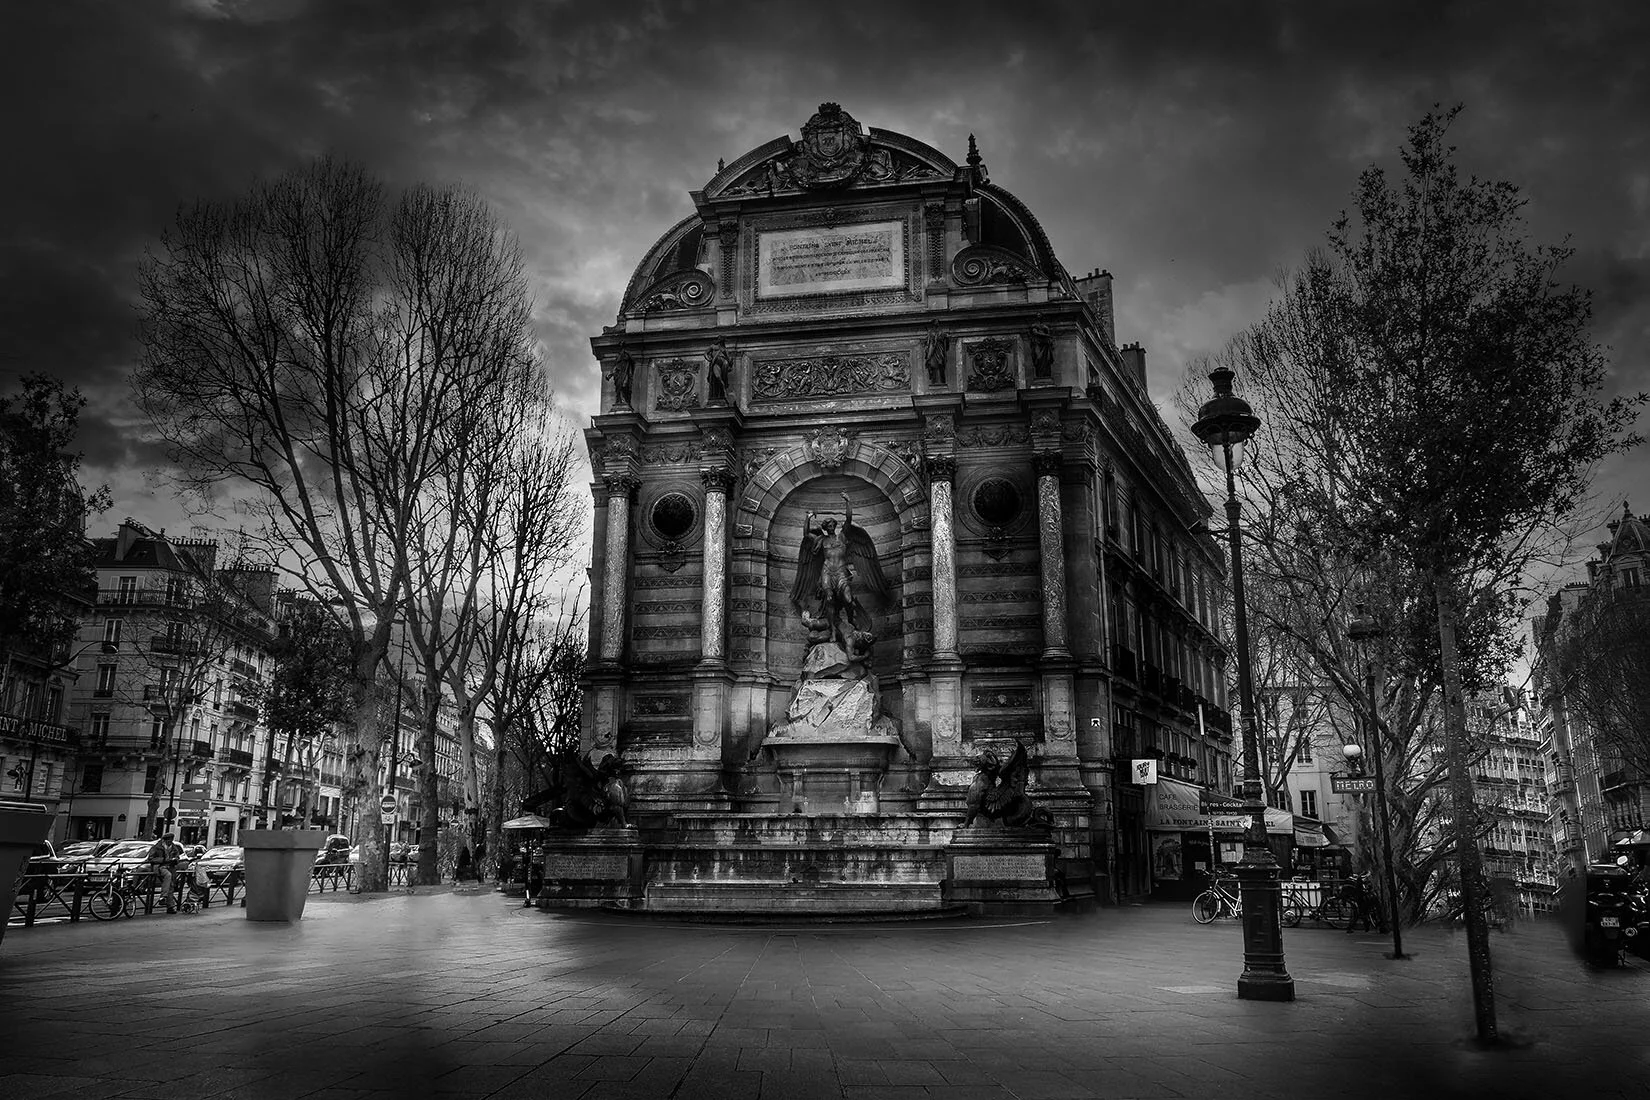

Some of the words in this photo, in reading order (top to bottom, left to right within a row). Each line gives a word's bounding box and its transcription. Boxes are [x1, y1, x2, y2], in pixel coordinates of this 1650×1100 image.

[28, 722, 67, 742] MICHEL
[1159, 803, 1199, 811] BRASSERIE
[1215, 819, 1241, 827] SAINT
